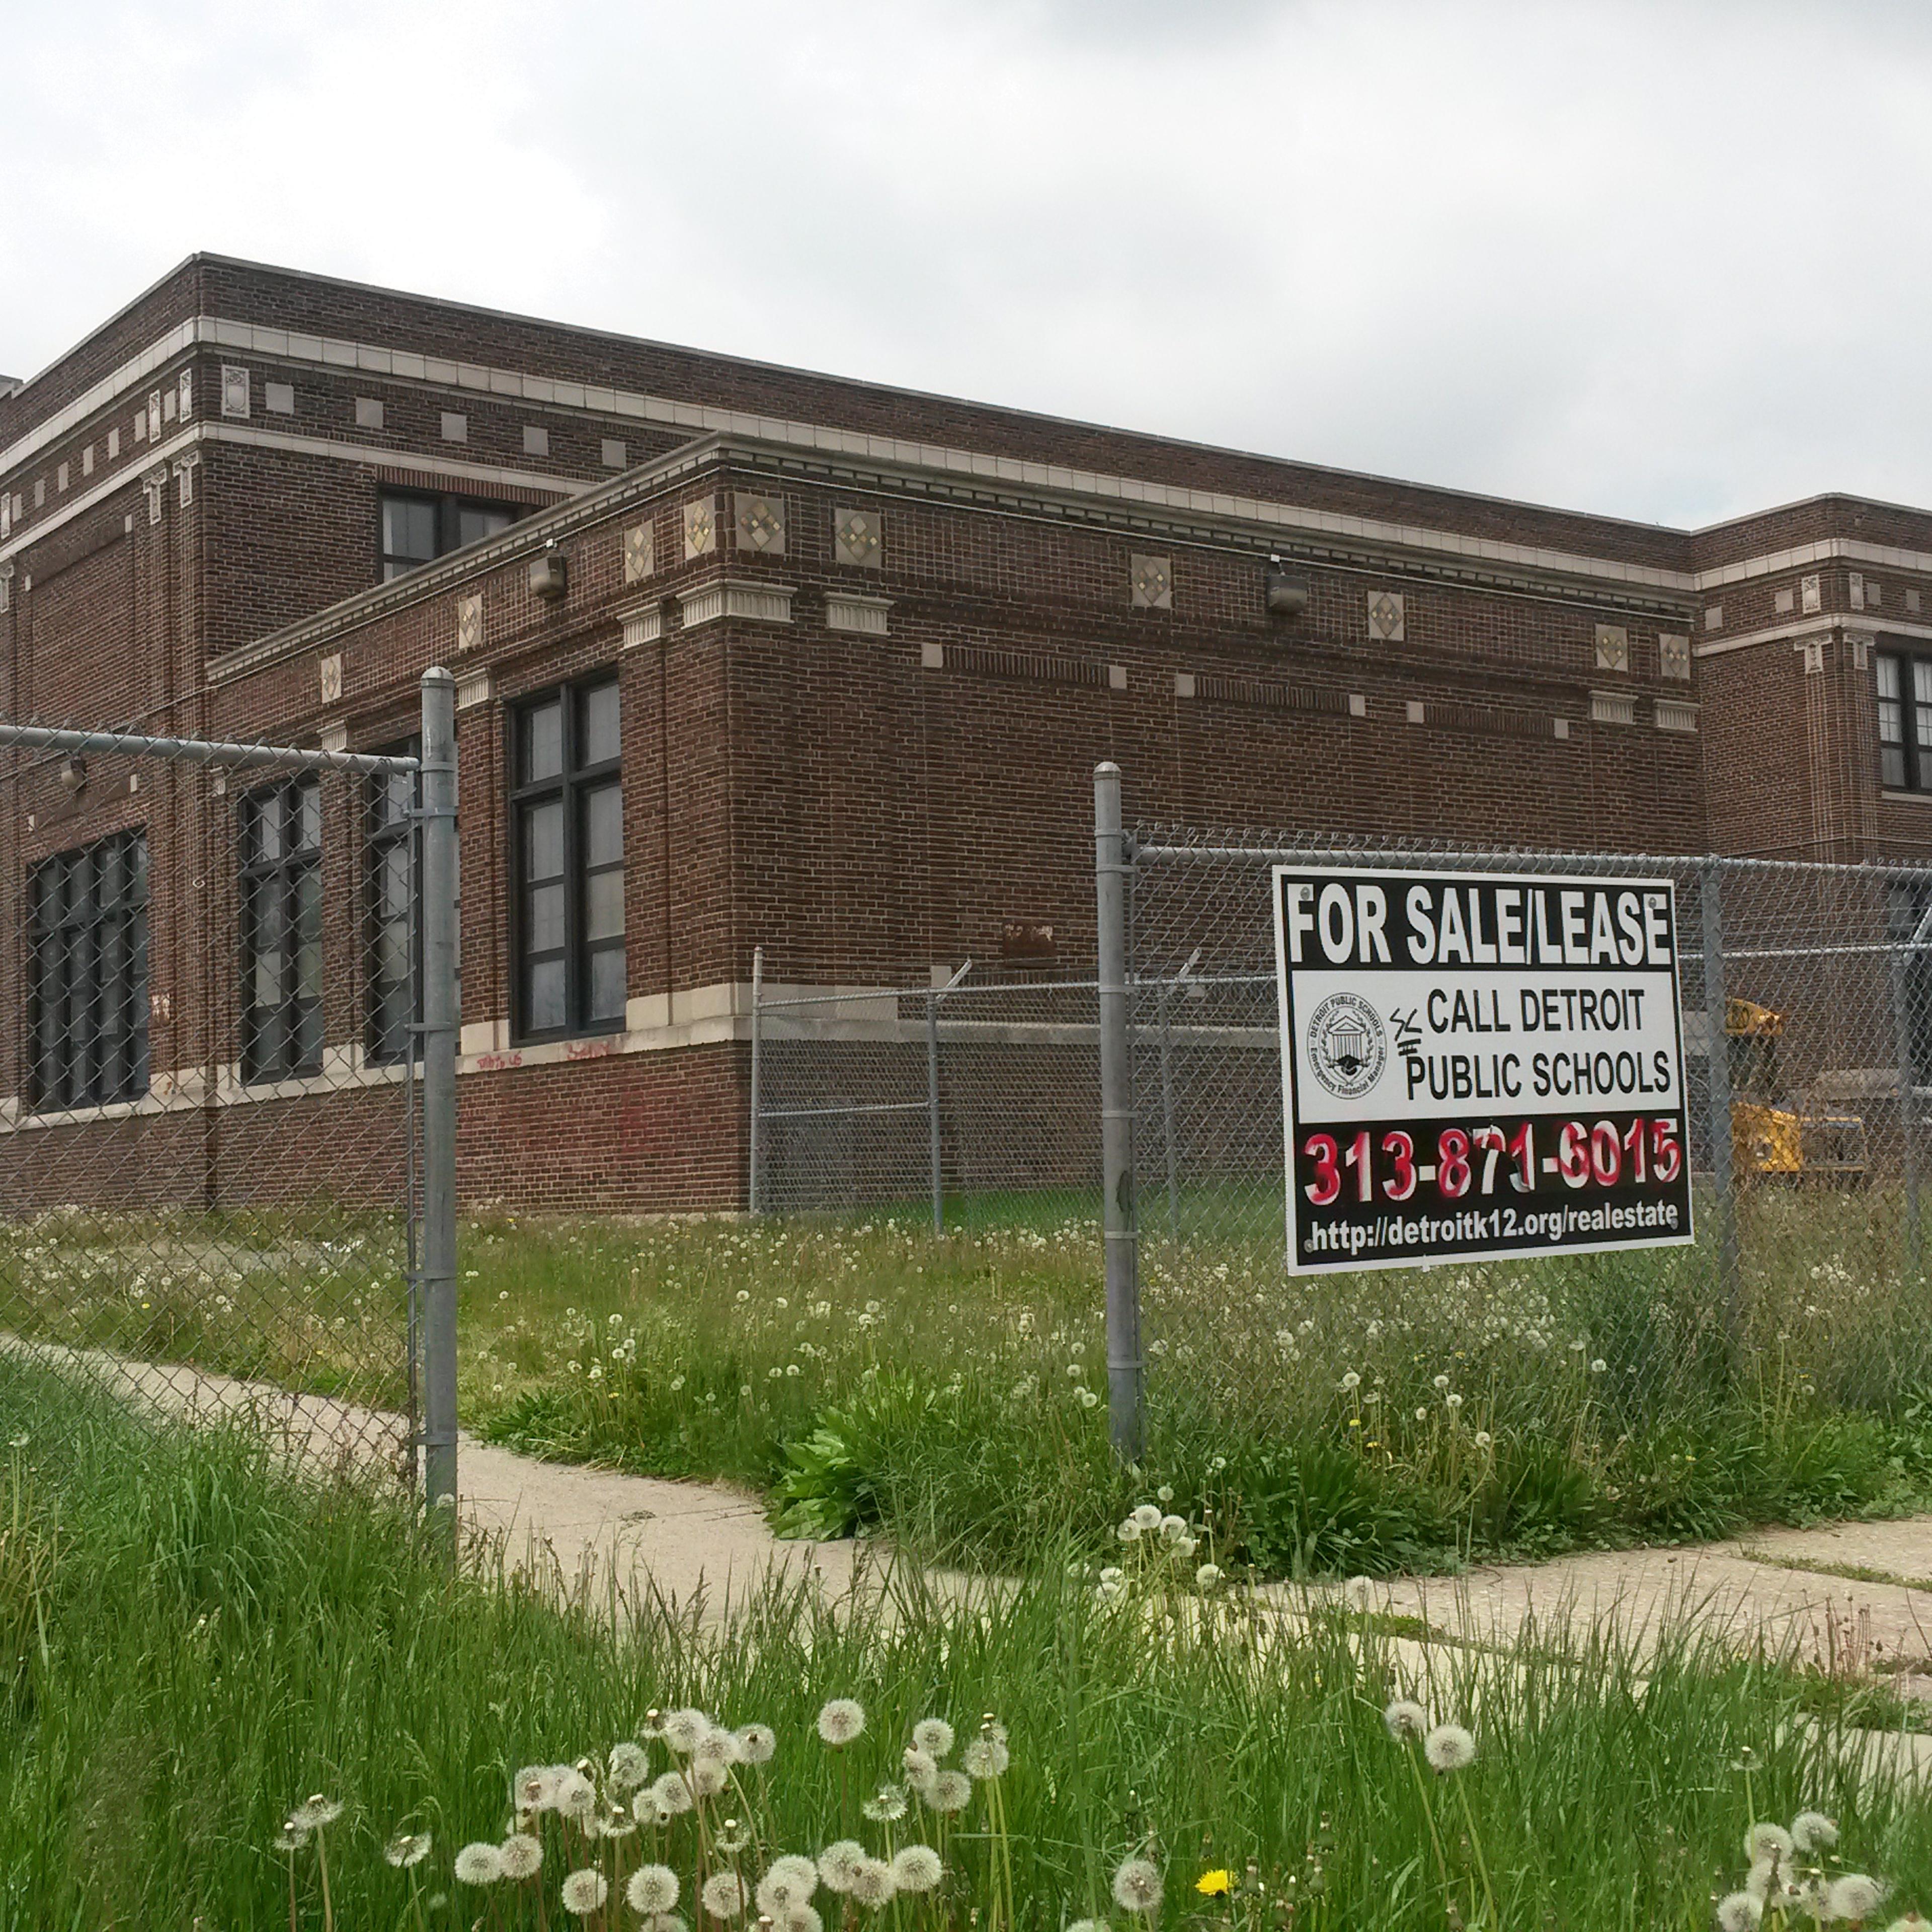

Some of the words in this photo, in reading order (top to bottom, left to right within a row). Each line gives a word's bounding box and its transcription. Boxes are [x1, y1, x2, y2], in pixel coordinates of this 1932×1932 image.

[1286, 883, 1392, 964] FOR
[1406, 885, 1672, 966] SALE/LEASE
[1310, 1002, 1331, 1038] DETROIT
[1330, 996, 1357, 1007] PUBLIC
[1358, 1000, 1383, 1037] SCHOOLS
[1427, 988, 1511, 1033] CALL
[1520, 988, 1645, 1031] DETROIT
[1310, 1047, 1336, 1091] Emergency
[1337, 1083, 1370, 1095] Financial
[1367, 1046, 1384, 1082] Manager
[1407, 1053, 1522, 1100] PUBLIC
[1533, 1051, 1671, 1096] SCHOOLS
[1311, 1200, 1679, 1256] http://detroitk12.org/realestate
